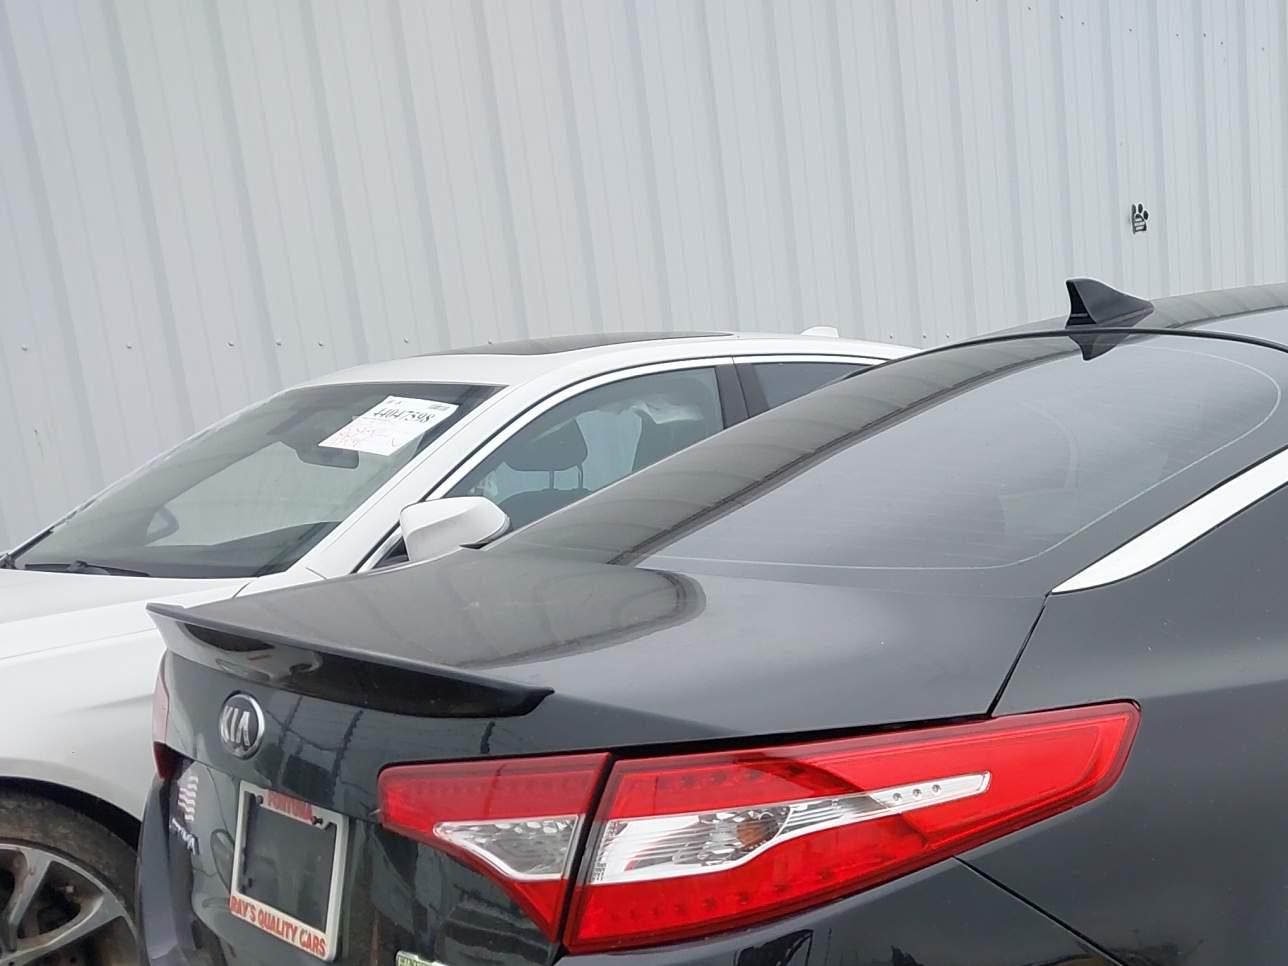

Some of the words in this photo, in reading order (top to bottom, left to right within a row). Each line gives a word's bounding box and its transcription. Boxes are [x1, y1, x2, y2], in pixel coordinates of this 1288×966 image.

[221, 705, 251, 746] KIA
[257, 907, 298, 942] QUALITY
[299, 927, 327, 958] CARS
